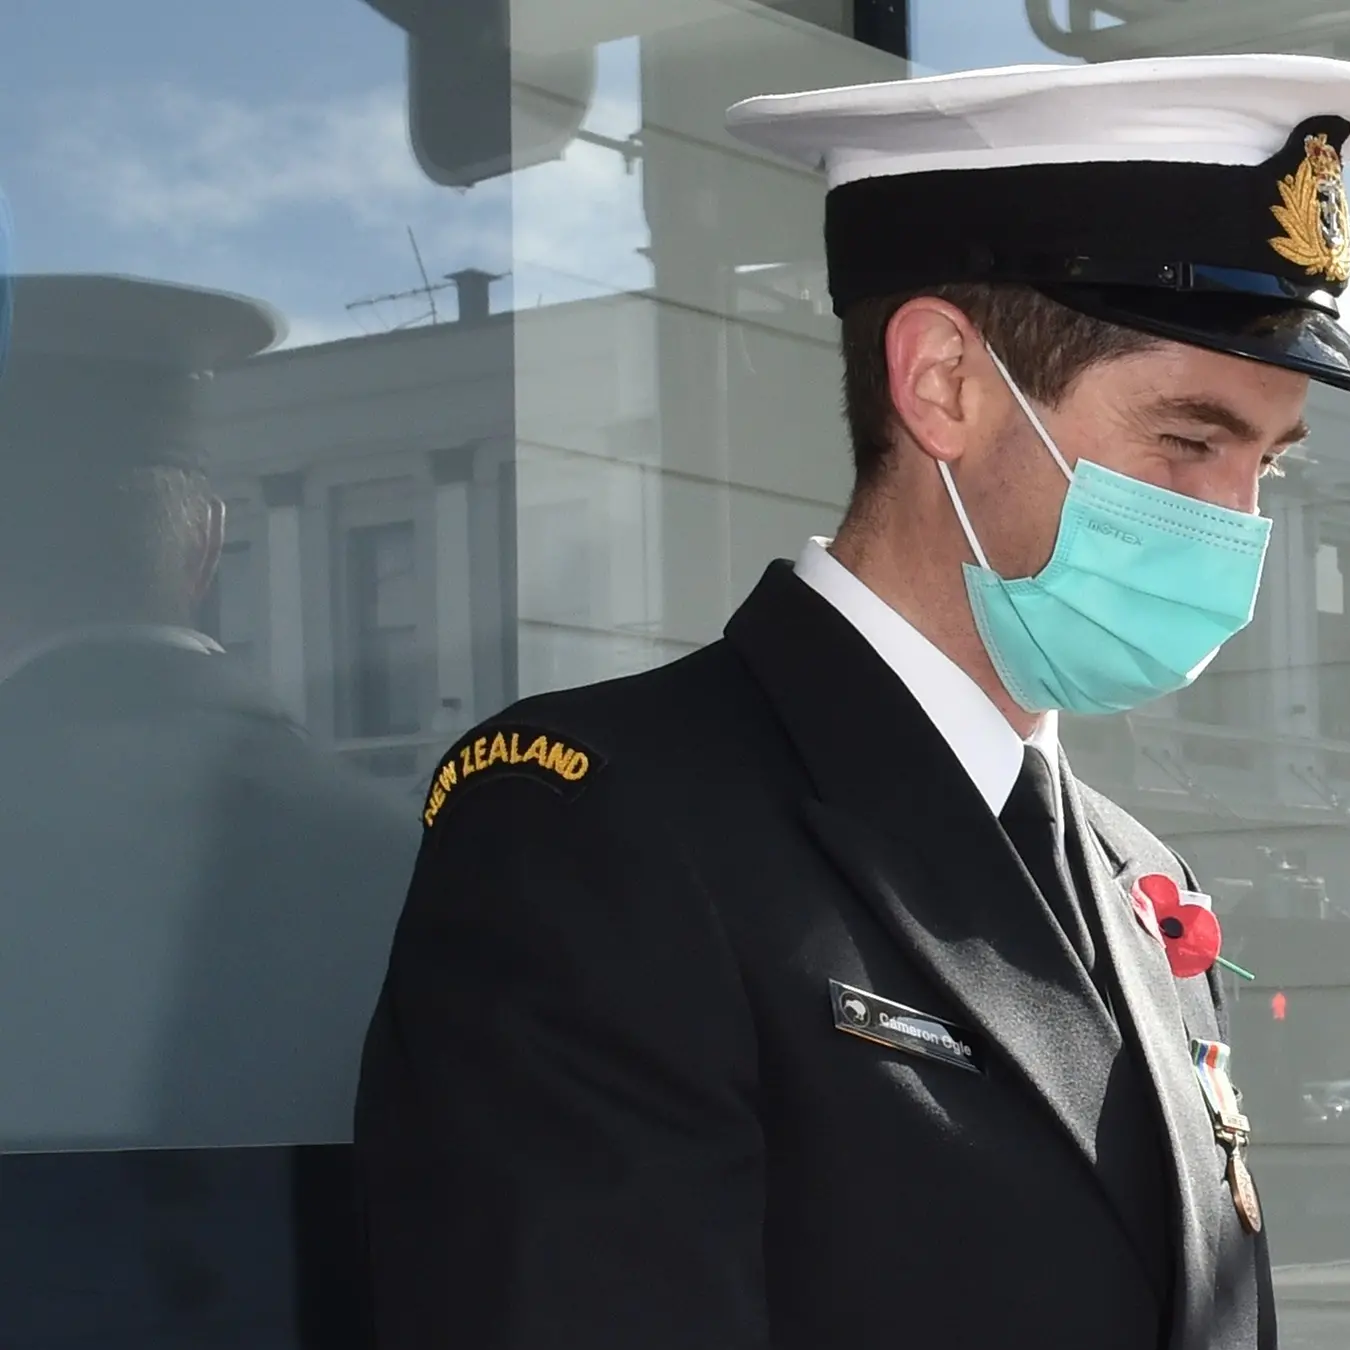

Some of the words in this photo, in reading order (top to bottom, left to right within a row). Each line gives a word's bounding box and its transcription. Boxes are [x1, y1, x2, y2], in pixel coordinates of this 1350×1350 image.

[424, 760, 457, 827] NEW
[460, 731, 589, 781] ZEALAND
[879, 1012, 939, 1045] Cameron
[941, 1035, 972, 1056] Ogle
